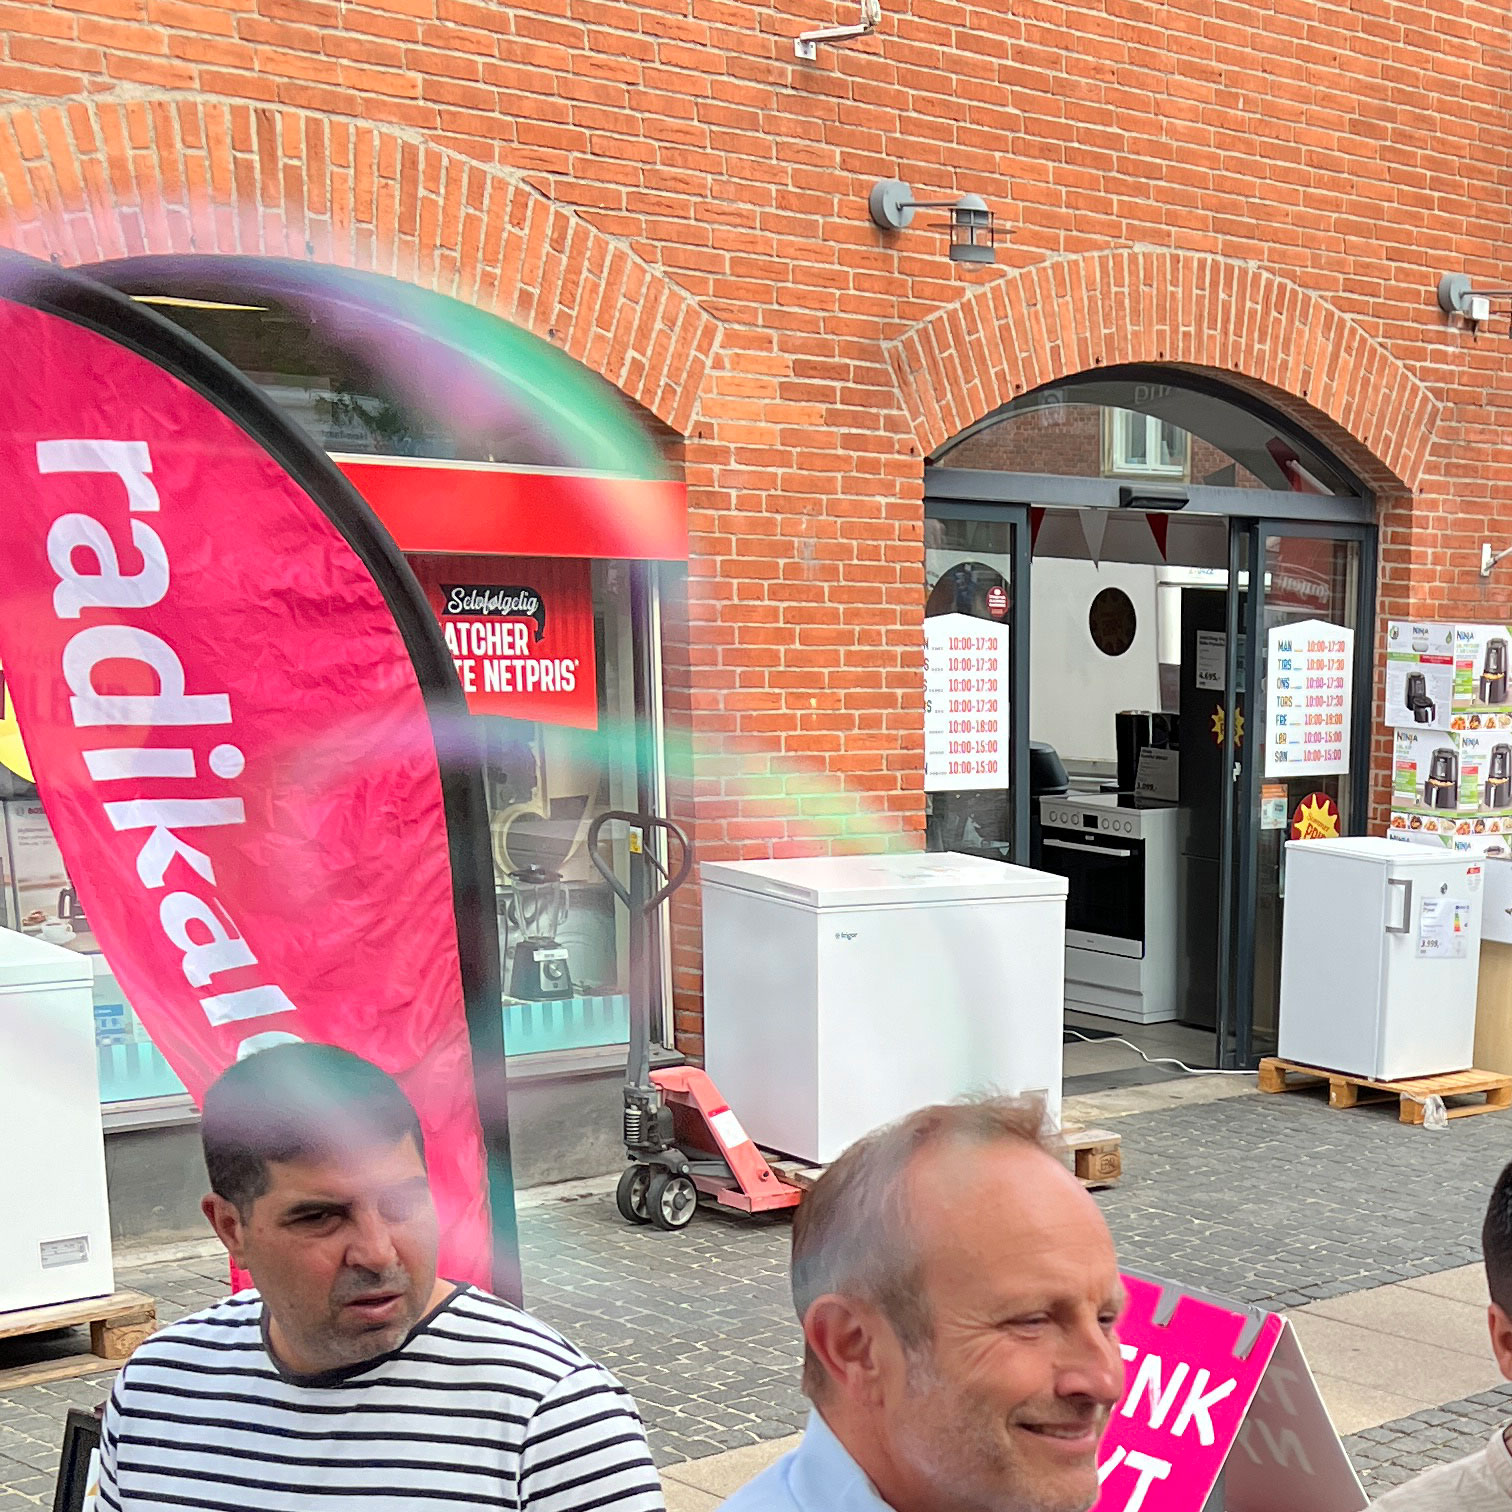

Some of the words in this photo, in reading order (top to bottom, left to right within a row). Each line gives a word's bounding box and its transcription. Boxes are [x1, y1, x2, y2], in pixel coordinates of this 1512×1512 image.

[439, 621, 530, 656] ATCHER
[1456, 630, 1475, 642] NINJA
[949, 637, 998, 650] 10:00-17:30
[1278, 640, 1292, 652] MAN
[1307, 640, 1346, 652] 10:00-17:30
[949, 658, 998, 672] 10:00-17:30
[1278, 658, 1292, 671] TIRS
[1306, 658, 1345, 671] 10:00-17:30
[949, 678, 998, 692] 10:00-17:30
[1276, 677, 1290, 690] ONS
[1306, 677, 1344, 690] 10:00-17:30
[949, 699, 998, 712] 10:00-17:30
[1277, 696, 1293, 708] TORS
[1305, 695, 1344, 708] 10:00-17:30
[1276, 714, 1288, 726] FRE
[1304, 713, 1343, 726] 10:00-18:00
[949, 720, 998, 734] 10:00-18:00
[1304, 731, 1342, 744] 10:00-15:00
[1396, 730, 1418, 745] NINJA
[1462, 736, 1480, 748] NINJA
[949, 740, 998, 754] 10:00-15:00
[1274, 750, 1288, 762] SØN
[1303, 749, 1342, 762] 10:00-15:00
[949, 760, 998, 774] 10:00-15:00
[1454, 840, 1472, 852] NINJA
[1119, 1343, 1238, 1447] NK
